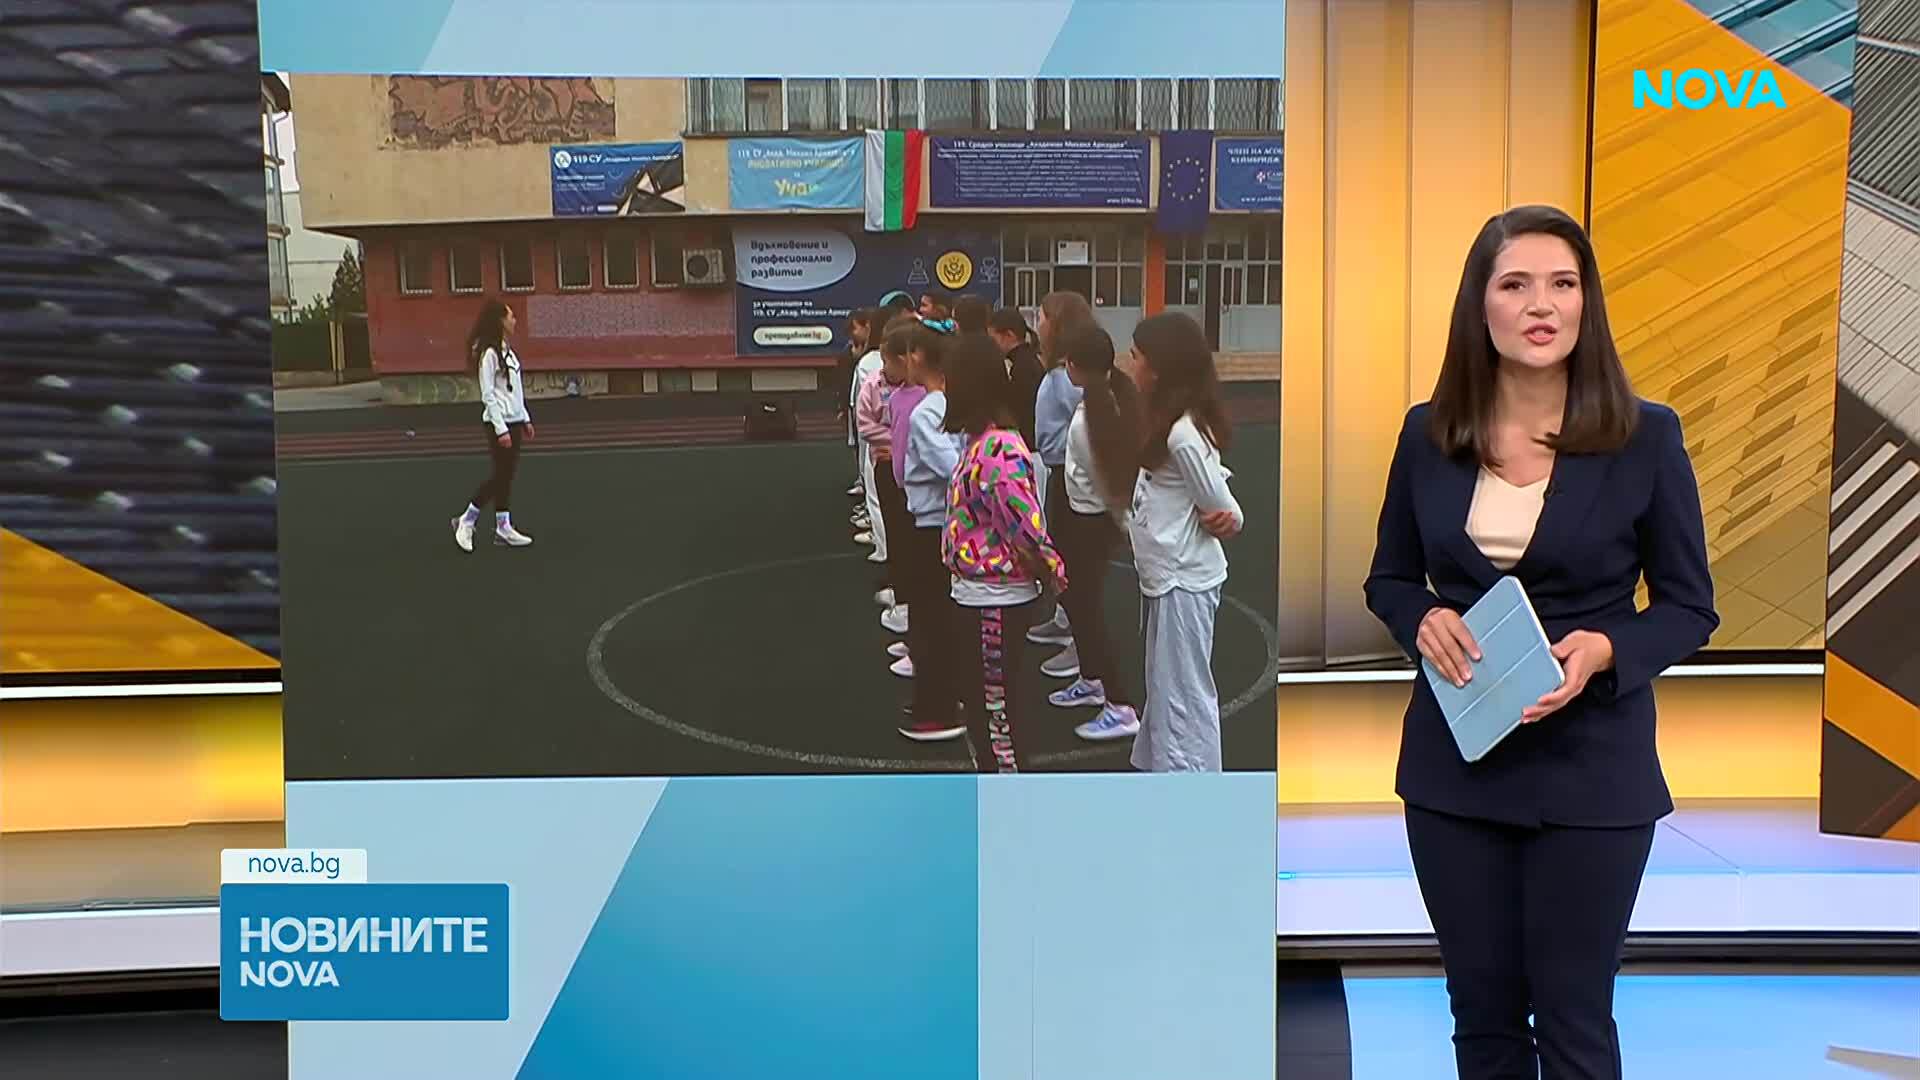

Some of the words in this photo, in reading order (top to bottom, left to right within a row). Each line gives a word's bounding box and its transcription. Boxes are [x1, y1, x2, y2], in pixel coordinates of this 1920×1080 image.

[822, 241, 829, 249] и
[751, 253, 833, 265] професионално
[751, 266, 803, 279] развитие
